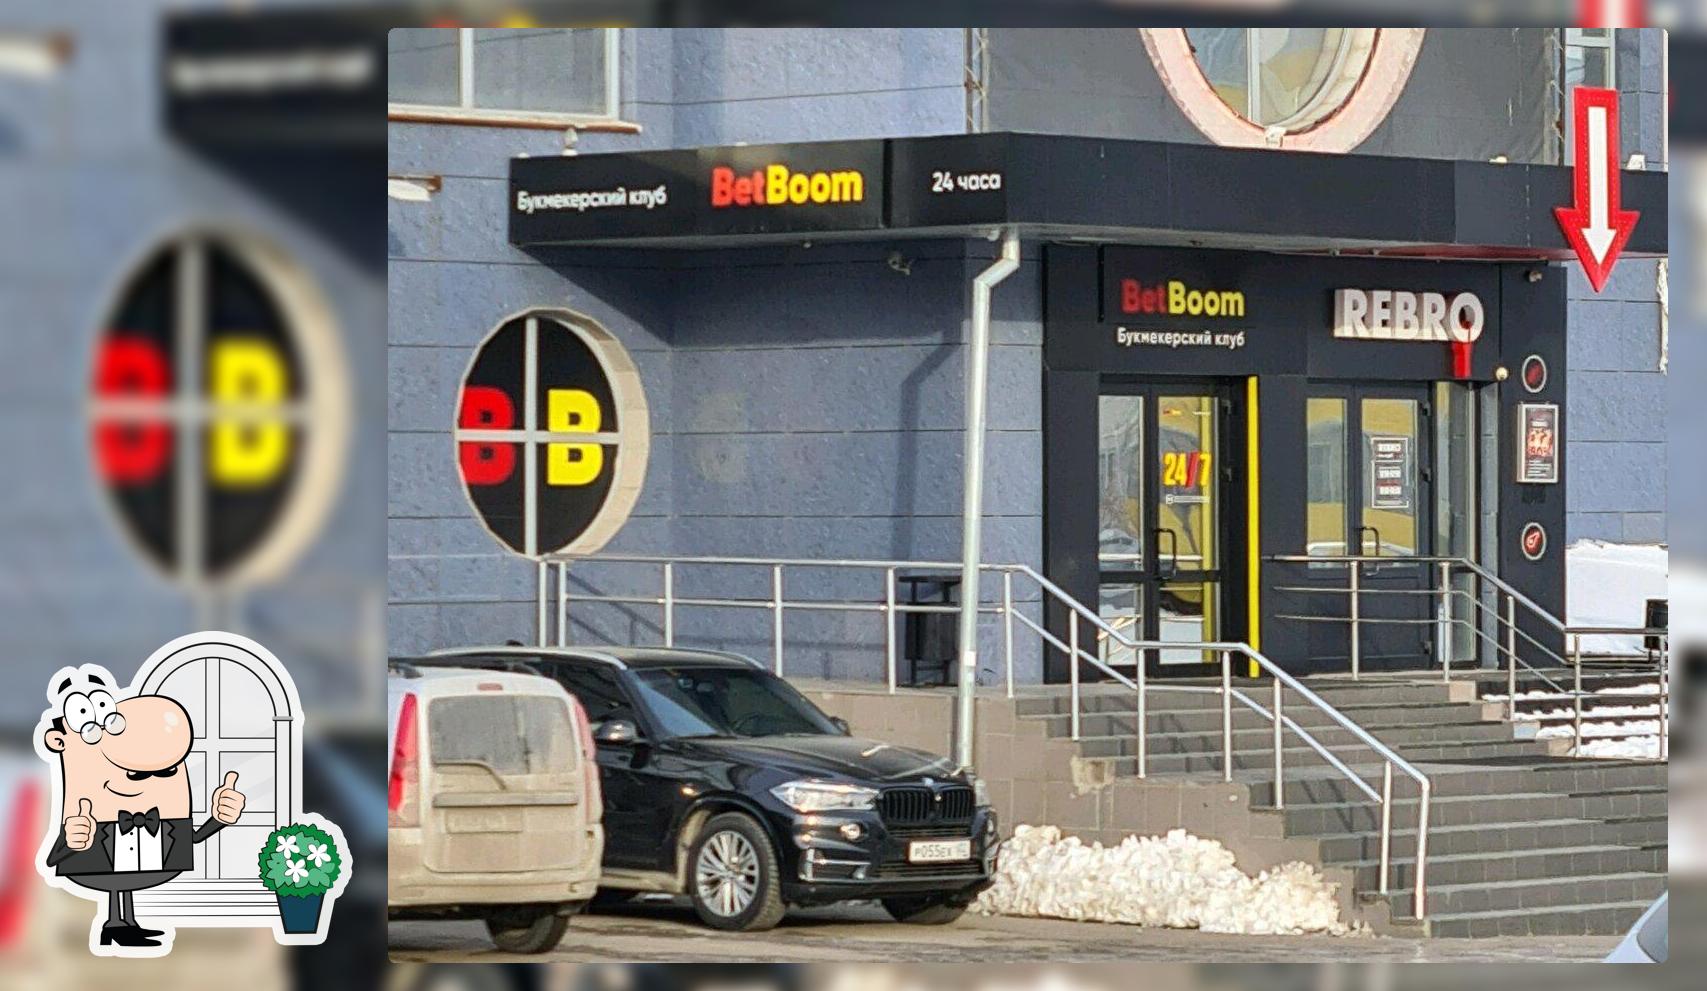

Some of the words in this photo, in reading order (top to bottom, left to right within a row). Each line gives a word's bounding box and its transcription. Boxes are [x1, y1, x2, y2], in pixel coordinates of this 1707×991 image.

[516, 186, 627, 214] Букмекерский
[628, 185, 668, 209] клуб
[711, 165, 864, 207] BetBoom
[931, 171, 954, 192] 24
[956, 172, 1001, 191] часа
[1120, 279, 1245, 317] BetBoom
[1333, 287, 1485, 344] REBRO
[1116, 327, 1212, 349] Букмекерский
[1214, 329, 1245, 348] клуб
[458, 386, 517, 486] B
[547, 388, 603, 486] B
[1162, 451, 1212, 489] 24/7
